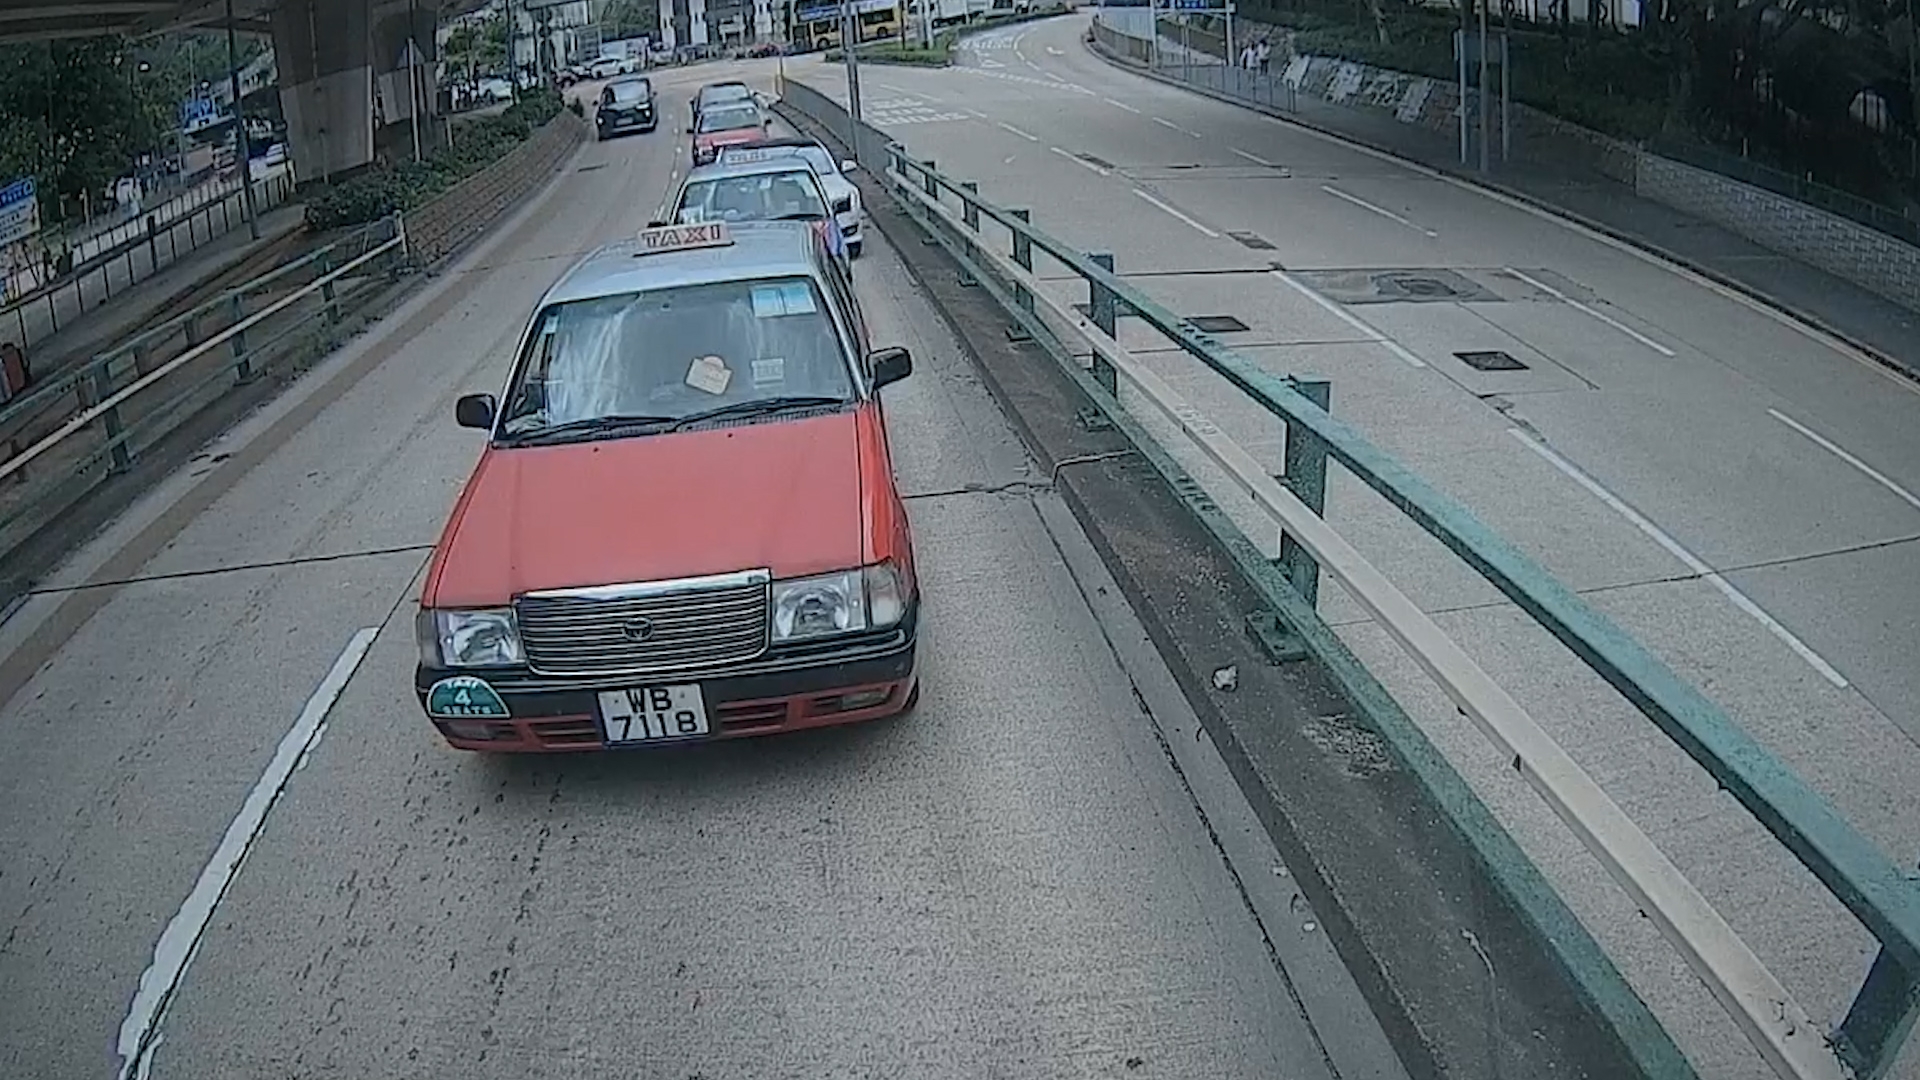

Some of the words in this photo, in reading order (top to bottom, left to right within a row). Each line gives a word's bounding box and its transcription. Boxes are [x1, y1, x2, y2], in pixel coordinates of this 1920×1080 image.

[642, 224, 720, 248] TAXI
[455, 688, 472, 706] 4
[626, 687, 672, 713] WB
[611, 711, 697, 739] 7118
